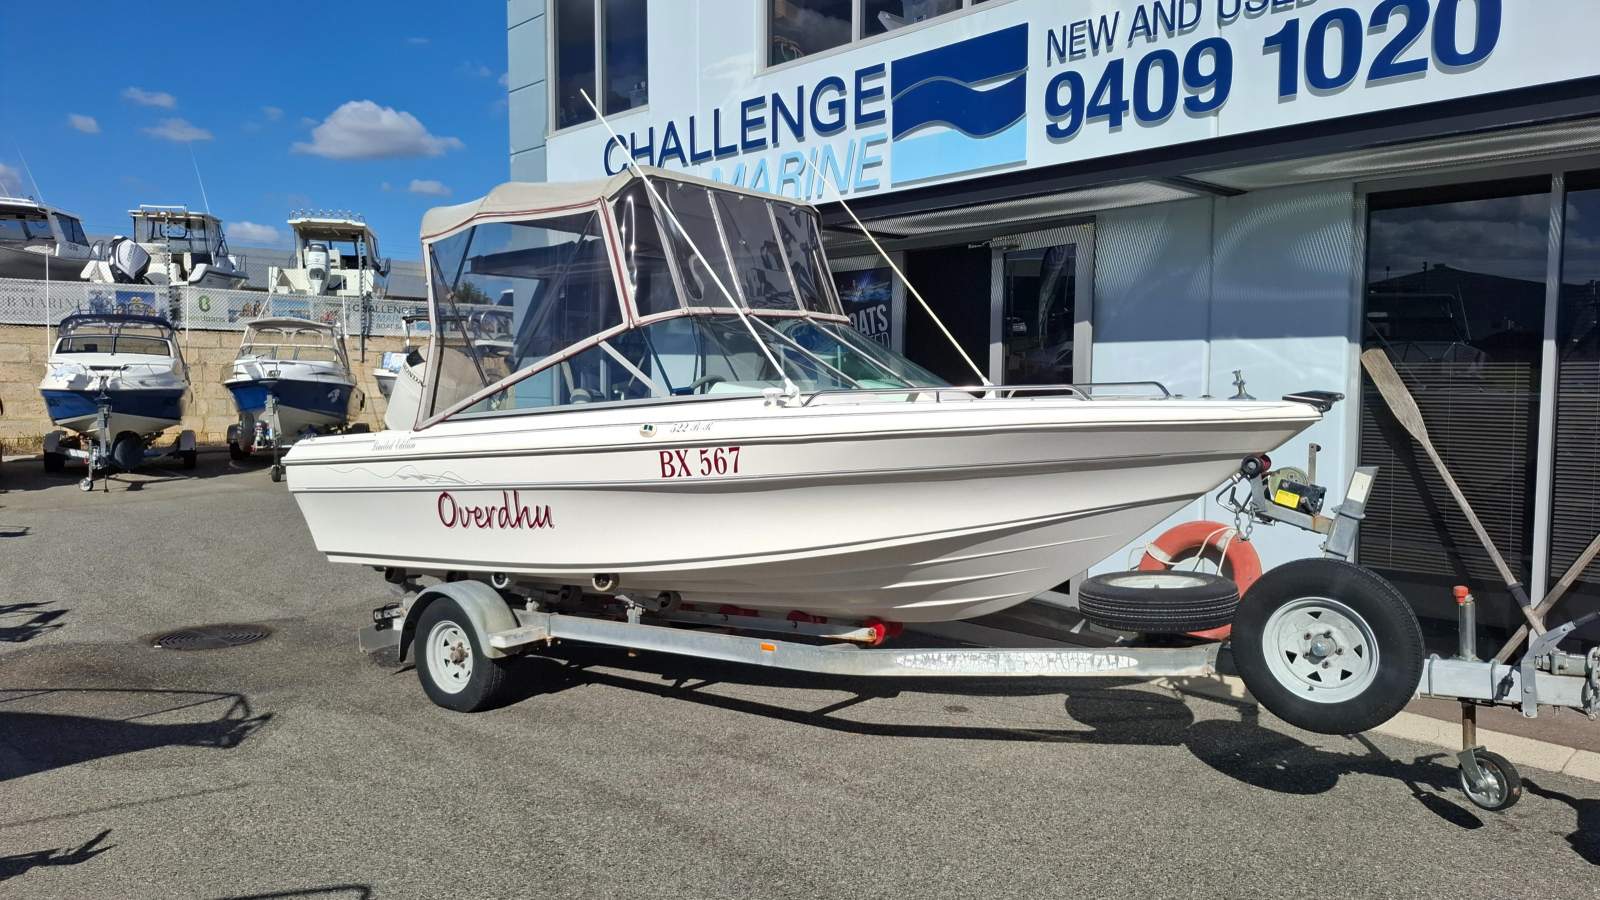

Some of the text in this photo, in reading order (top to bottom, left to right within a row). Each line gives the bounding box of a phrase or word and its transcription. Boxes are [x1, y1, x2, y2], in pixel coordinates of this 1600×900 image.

[1045, 11, 1120, 66] NEW
[1127, 0, 1204, 48] AND
[1044, 0, 1502, 141] 9409 1020
[603, 62, 887, 177] CHALLENGE
[711, 132, 888, 200] MARINE
[848, 304, 889, 336] OATS
[659, 446, 740, 478] BX 567
[438, 489, 554, 529] Overdhu
